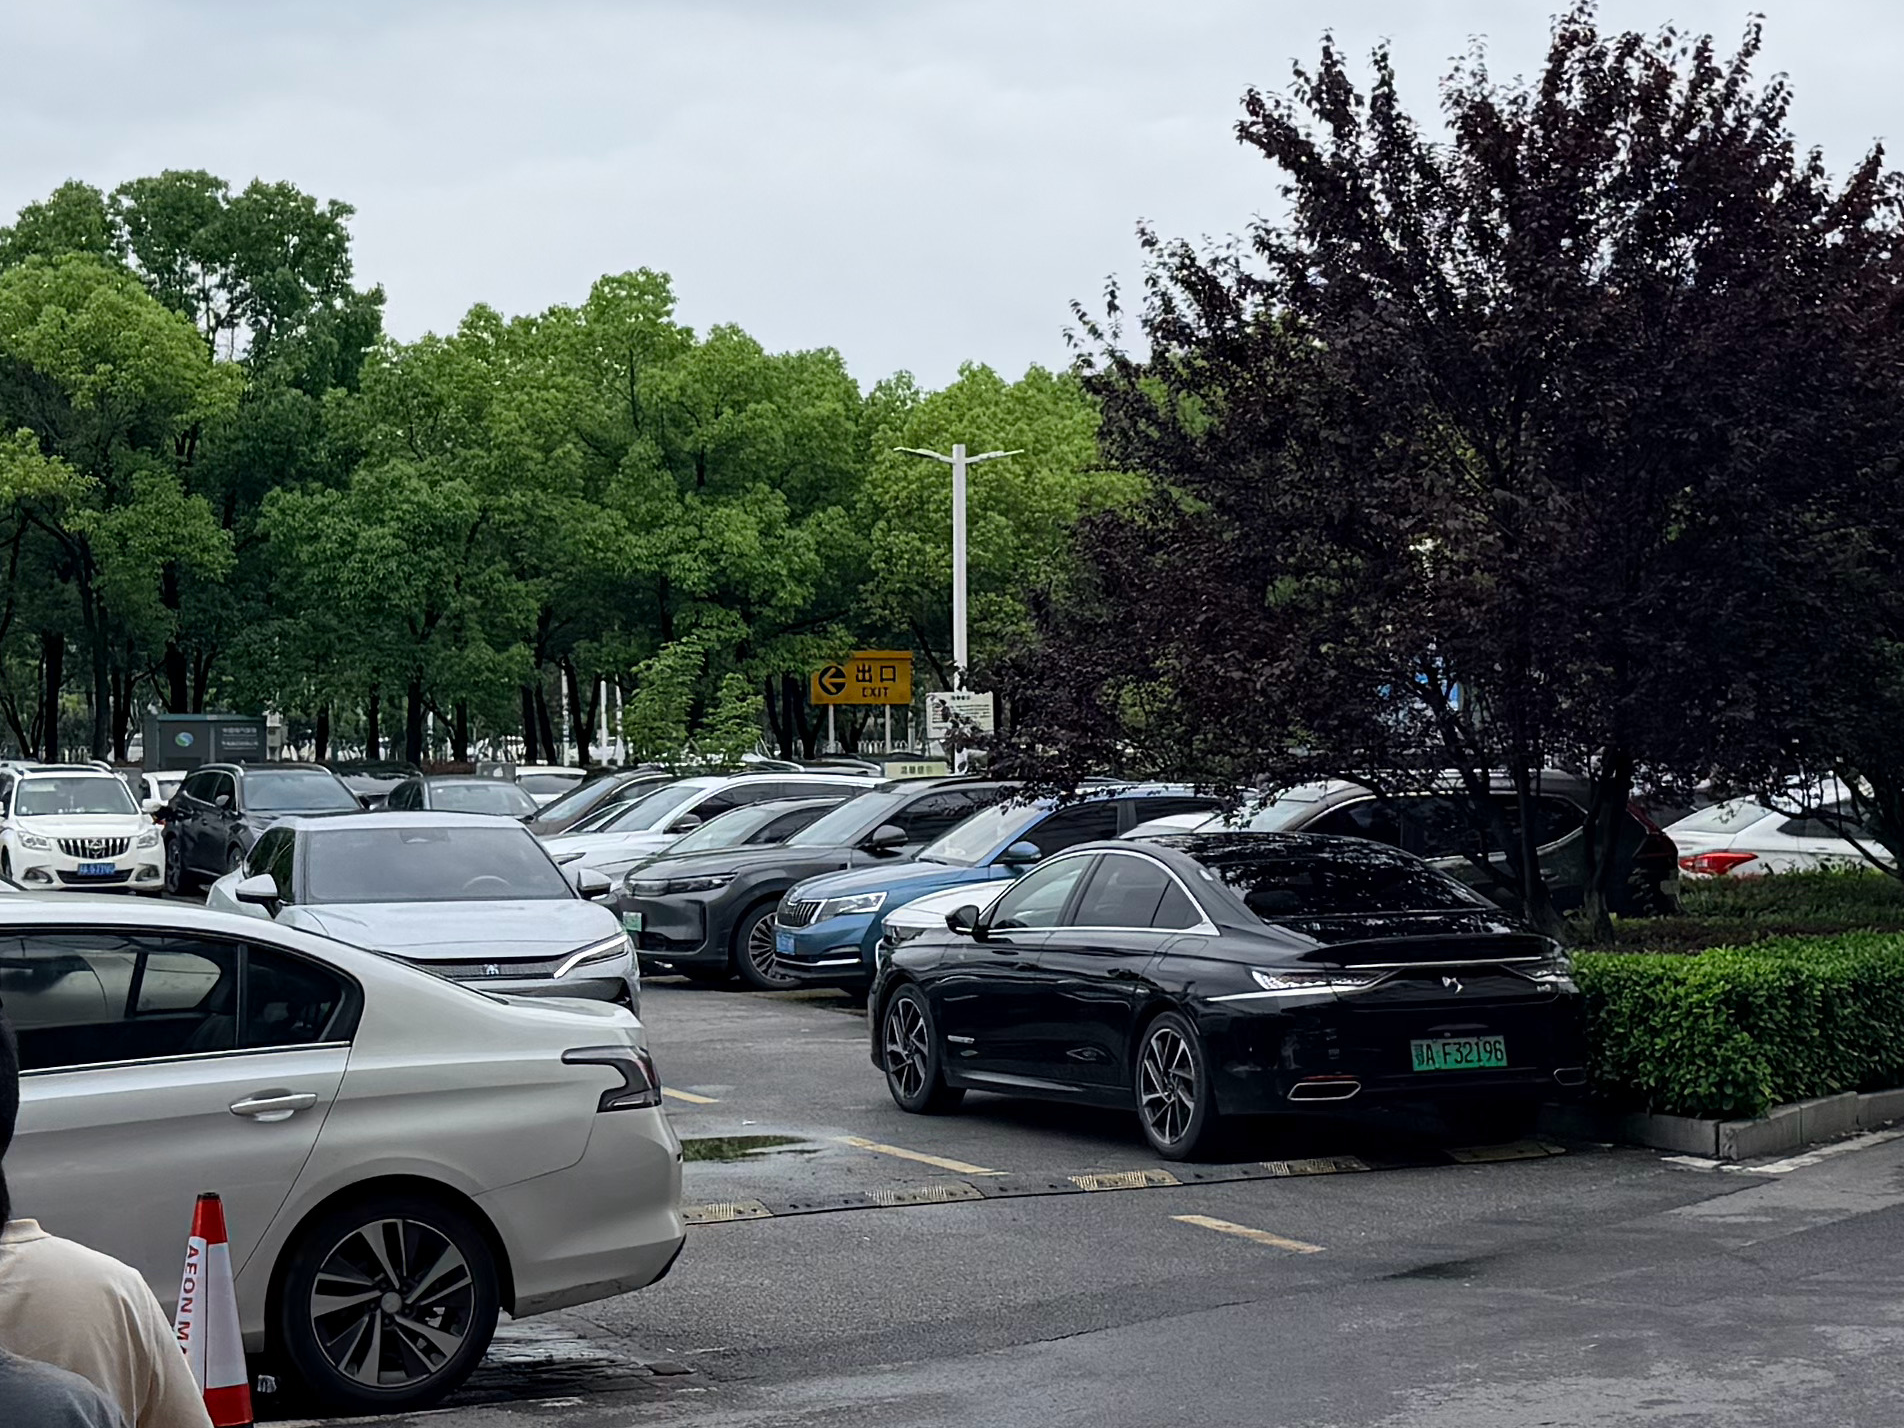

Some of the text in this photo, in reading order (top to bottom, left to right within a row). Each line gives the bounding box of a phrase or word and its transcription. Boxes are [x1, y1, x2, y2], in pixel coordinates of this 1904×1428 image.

[856, 664, 896, 684] 出口
[862, 687, 890, 698] EXIT
[180, 1244, 200, 1313] AEON
